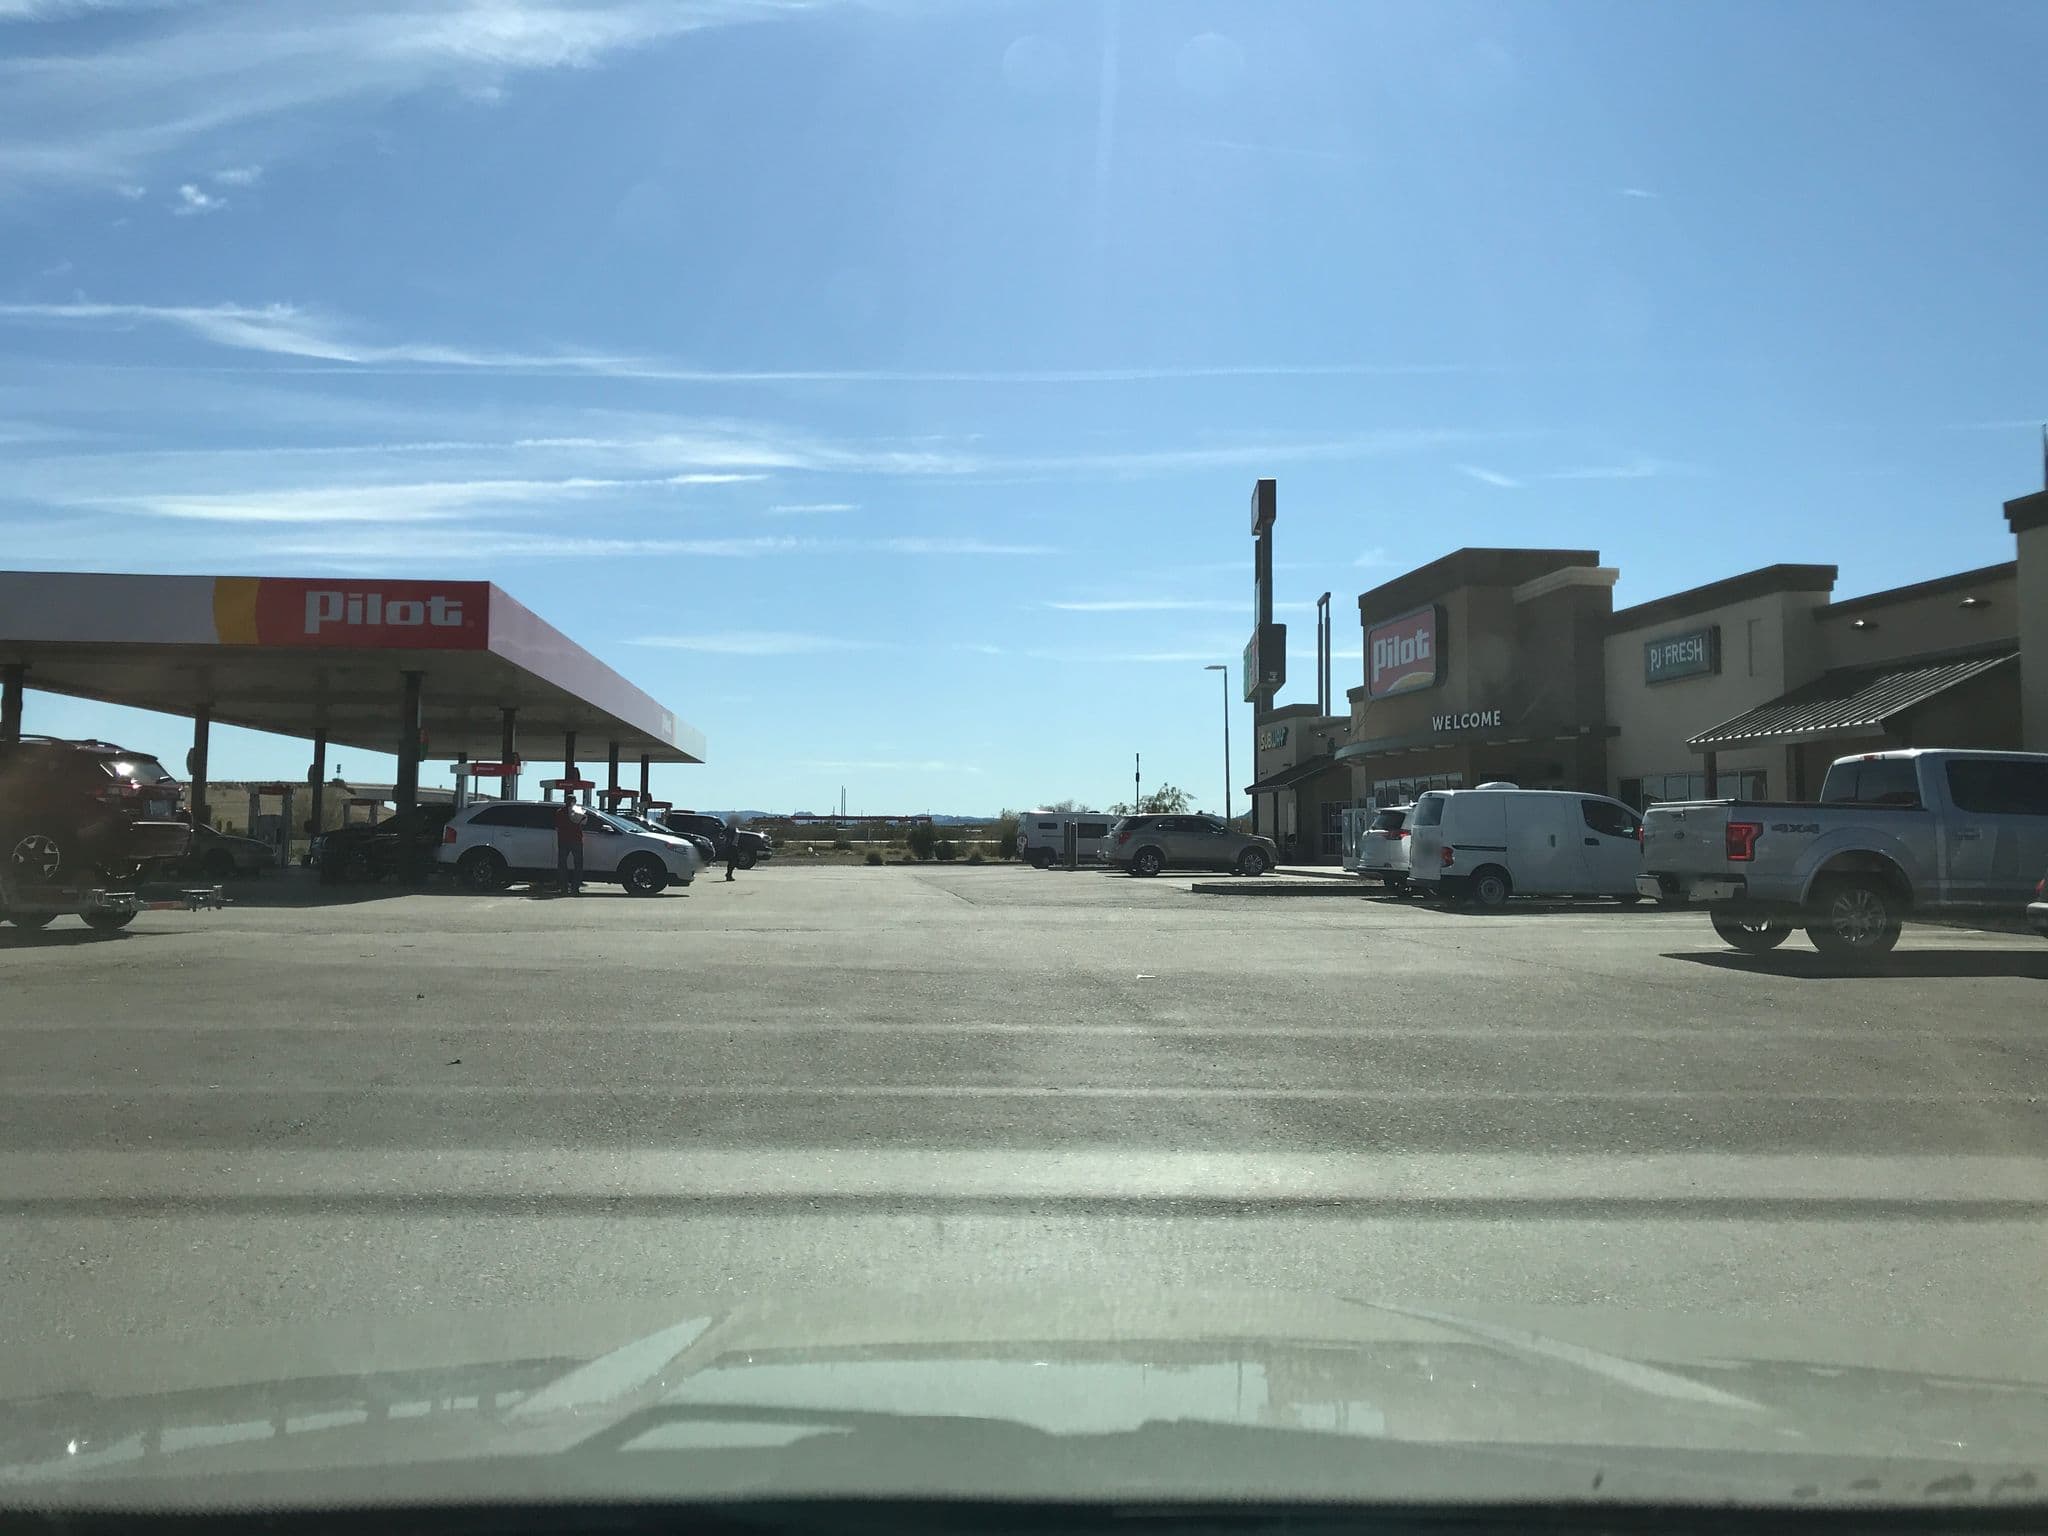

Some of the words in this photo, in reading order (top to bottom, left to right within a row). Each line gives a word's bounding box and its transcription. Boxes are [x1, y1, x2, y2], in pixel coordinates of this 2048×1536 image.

[304, 590, 463, 634] Pilot
[1373, 629, 1430, 683] Pilot
[1665, 638, 1703, 665] FRESH
[1432, 710, 1501, 731] WELCOME
